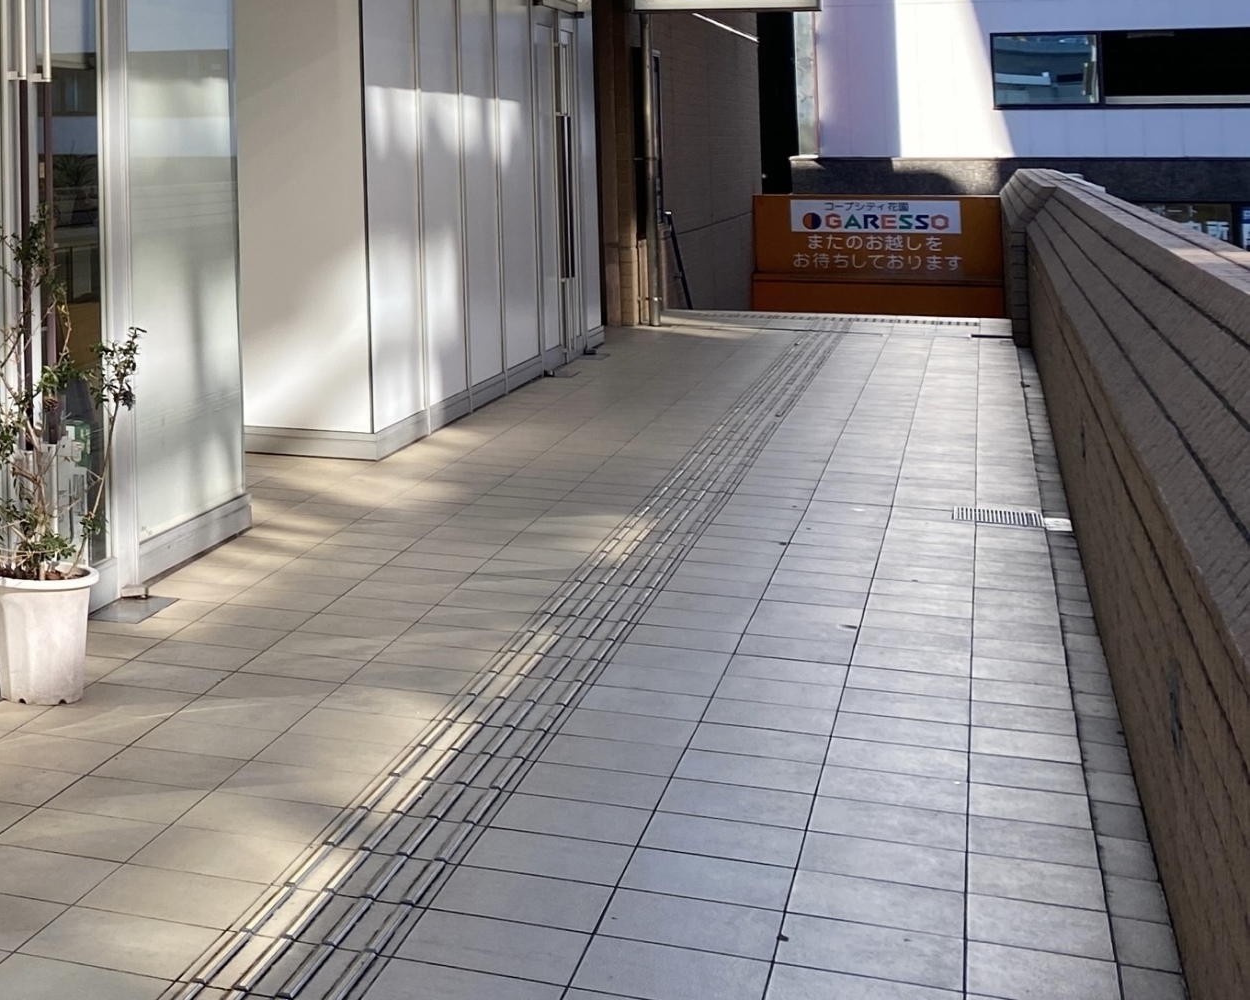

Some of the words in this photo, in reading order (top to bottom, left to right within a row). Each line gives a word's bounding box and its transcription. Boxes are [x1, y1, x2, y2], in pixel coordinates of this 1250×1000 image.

[824, 202, 909, 212] コープシティ花園
[825, 213, 949, 230] GARESSO
[807, 235, 942, 251] またのお越しを
[793, 253, 963, 271] お待ちしております
